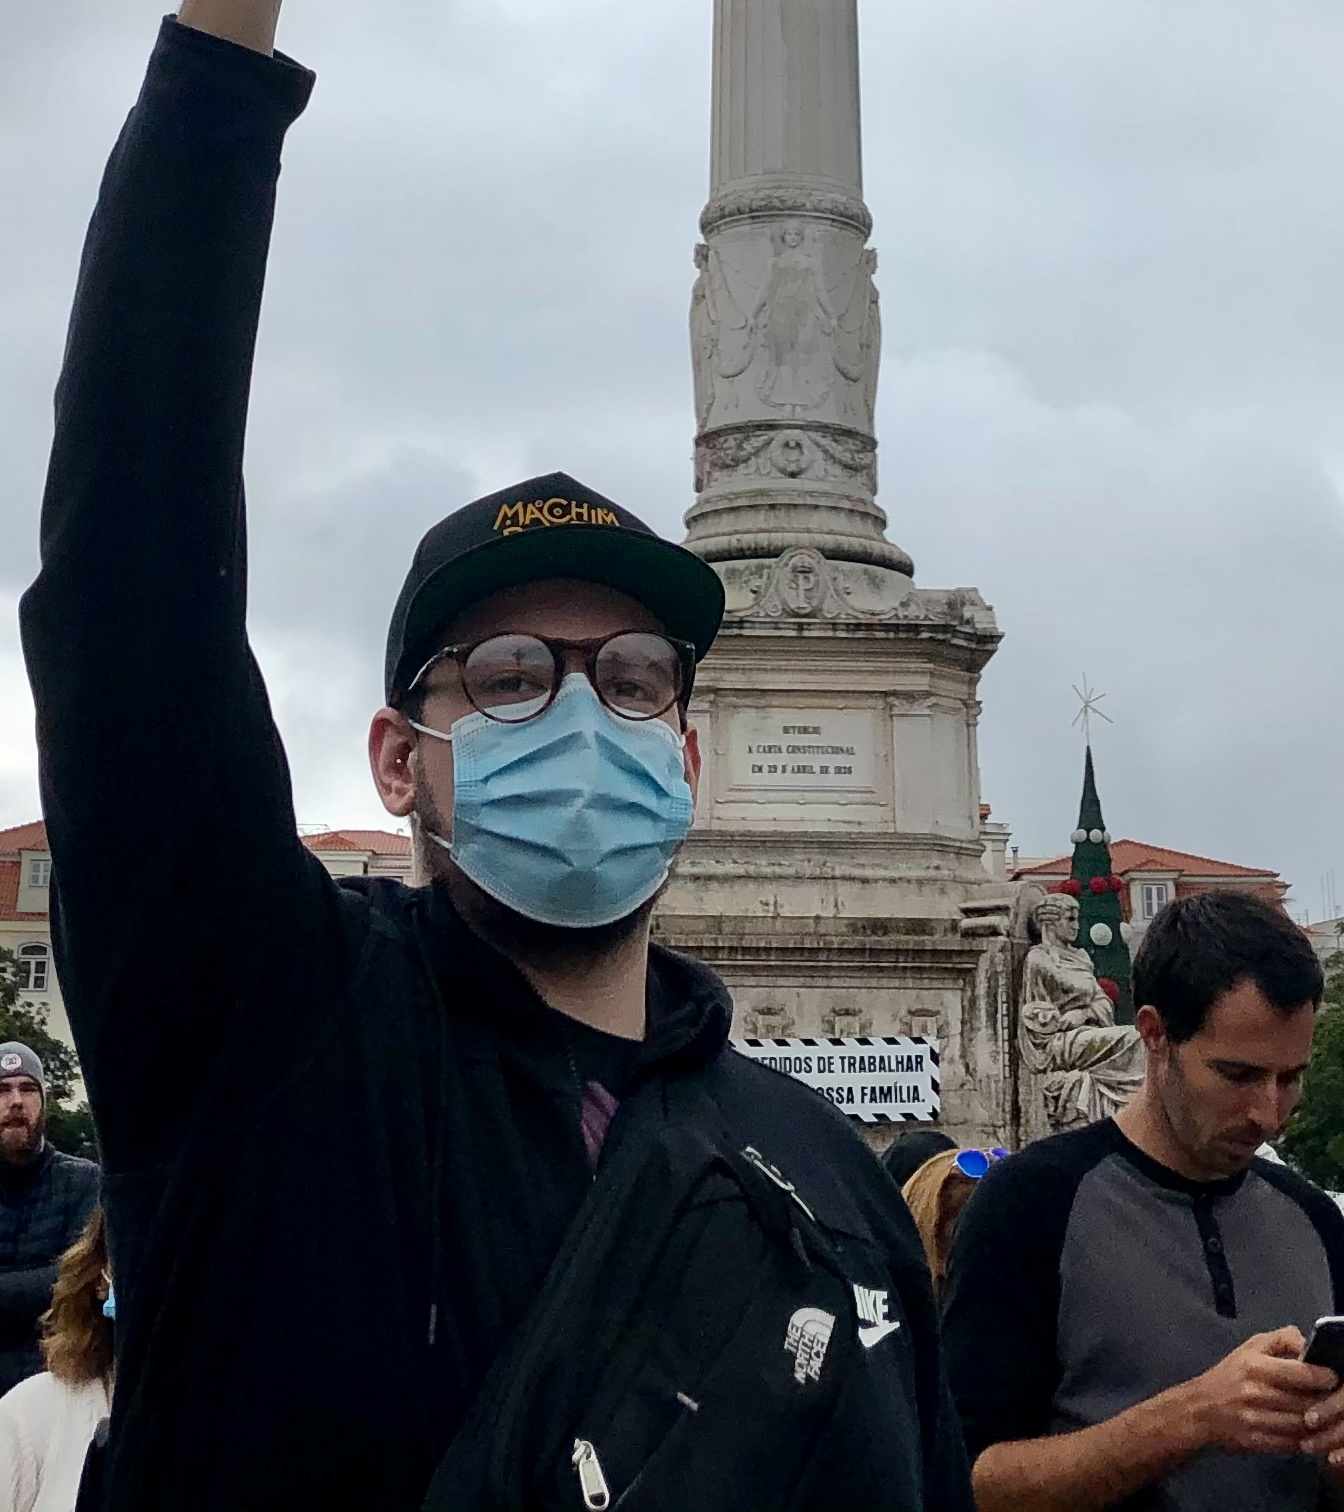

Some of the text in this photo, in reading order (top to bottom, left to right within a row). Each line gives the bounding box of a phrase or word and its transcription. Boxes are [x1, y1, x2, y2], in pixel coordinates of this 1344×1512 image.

[817, 1055, 835, 1074] DE
[840, 1054, 924, 1073] TRABALHAR
[860, 1081, 926, 1104] FAMÍLIA.
